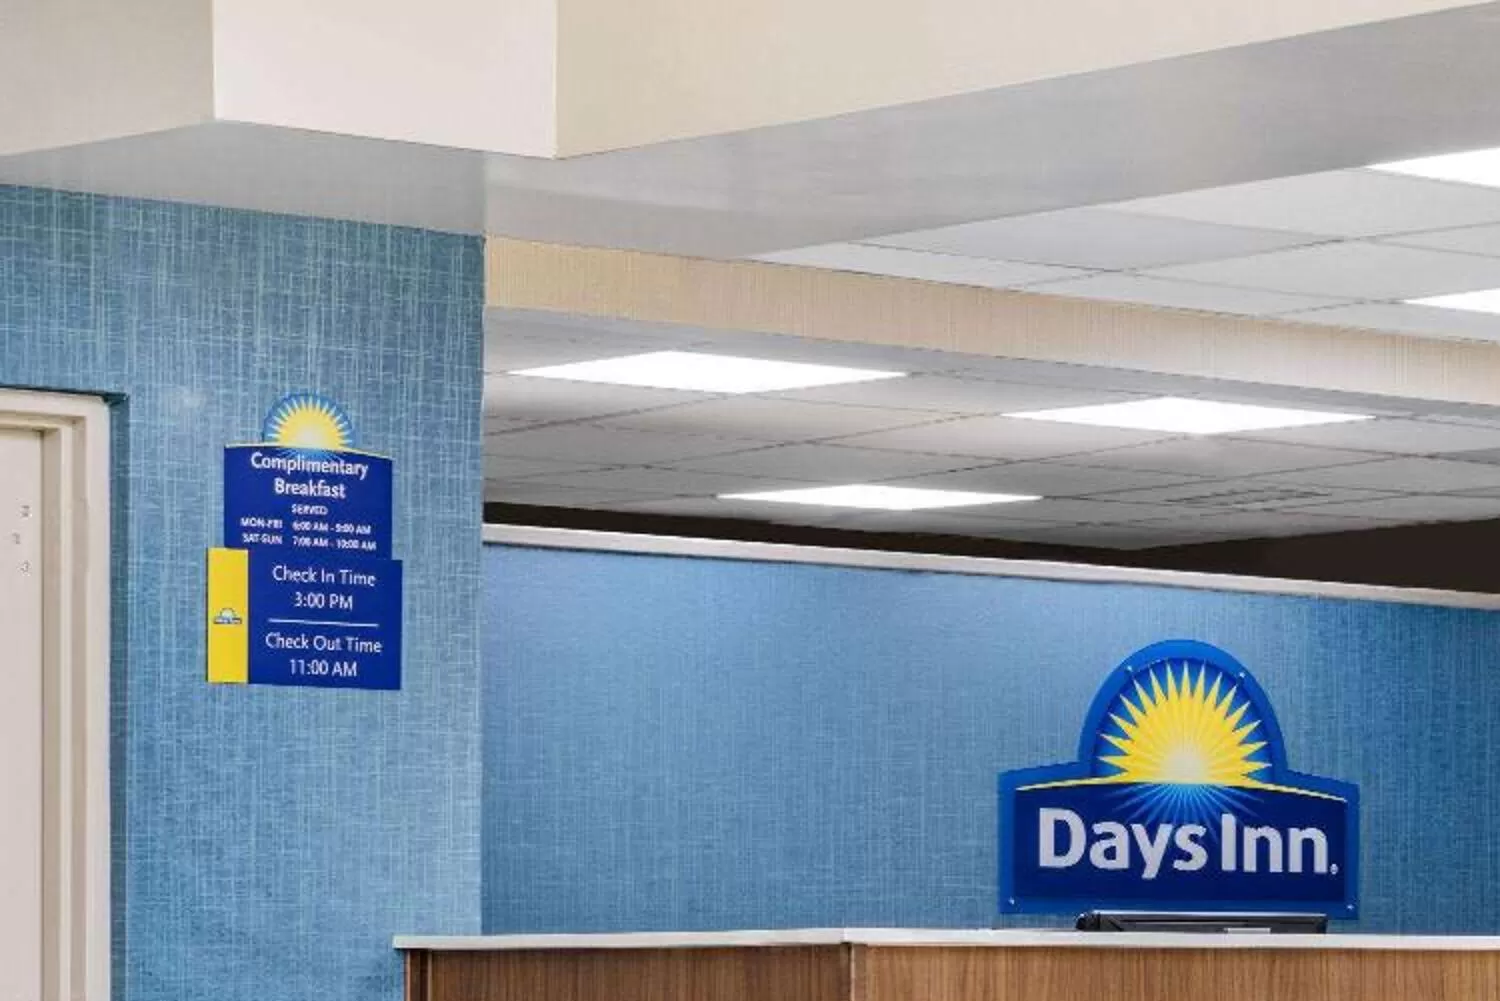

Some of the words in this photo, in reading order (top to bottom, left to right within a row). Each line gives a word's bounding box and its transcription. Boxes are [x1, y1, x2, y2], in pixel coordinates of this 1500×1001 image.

[250, 452, 369, 479] Complimentary
[274, 478, 346, 499] Breakfast
[291, 504, 328, 516] SERVED
[313, 522, 329, 532] AM
[355, 525, 371, 535] AM
[313, 537, 329, 548] AM
[361, 541, 377, 551] AM
[272, 565, 316, 583] Check
[321, 567, 335, 583] In
[339, 569, 377, 586] Time
[294, 592, 325, 608] 3:00
[329, 593, 353, 609] PM
[265, 632, 309, 650] Check
[313, 635, 342, 651] Out
[346, 637, 382, 653] Time
[290, 659, 329, 676] 11:00
[331, 660, 357, 677] AM
[1039, 807, 1208, 880] Days
